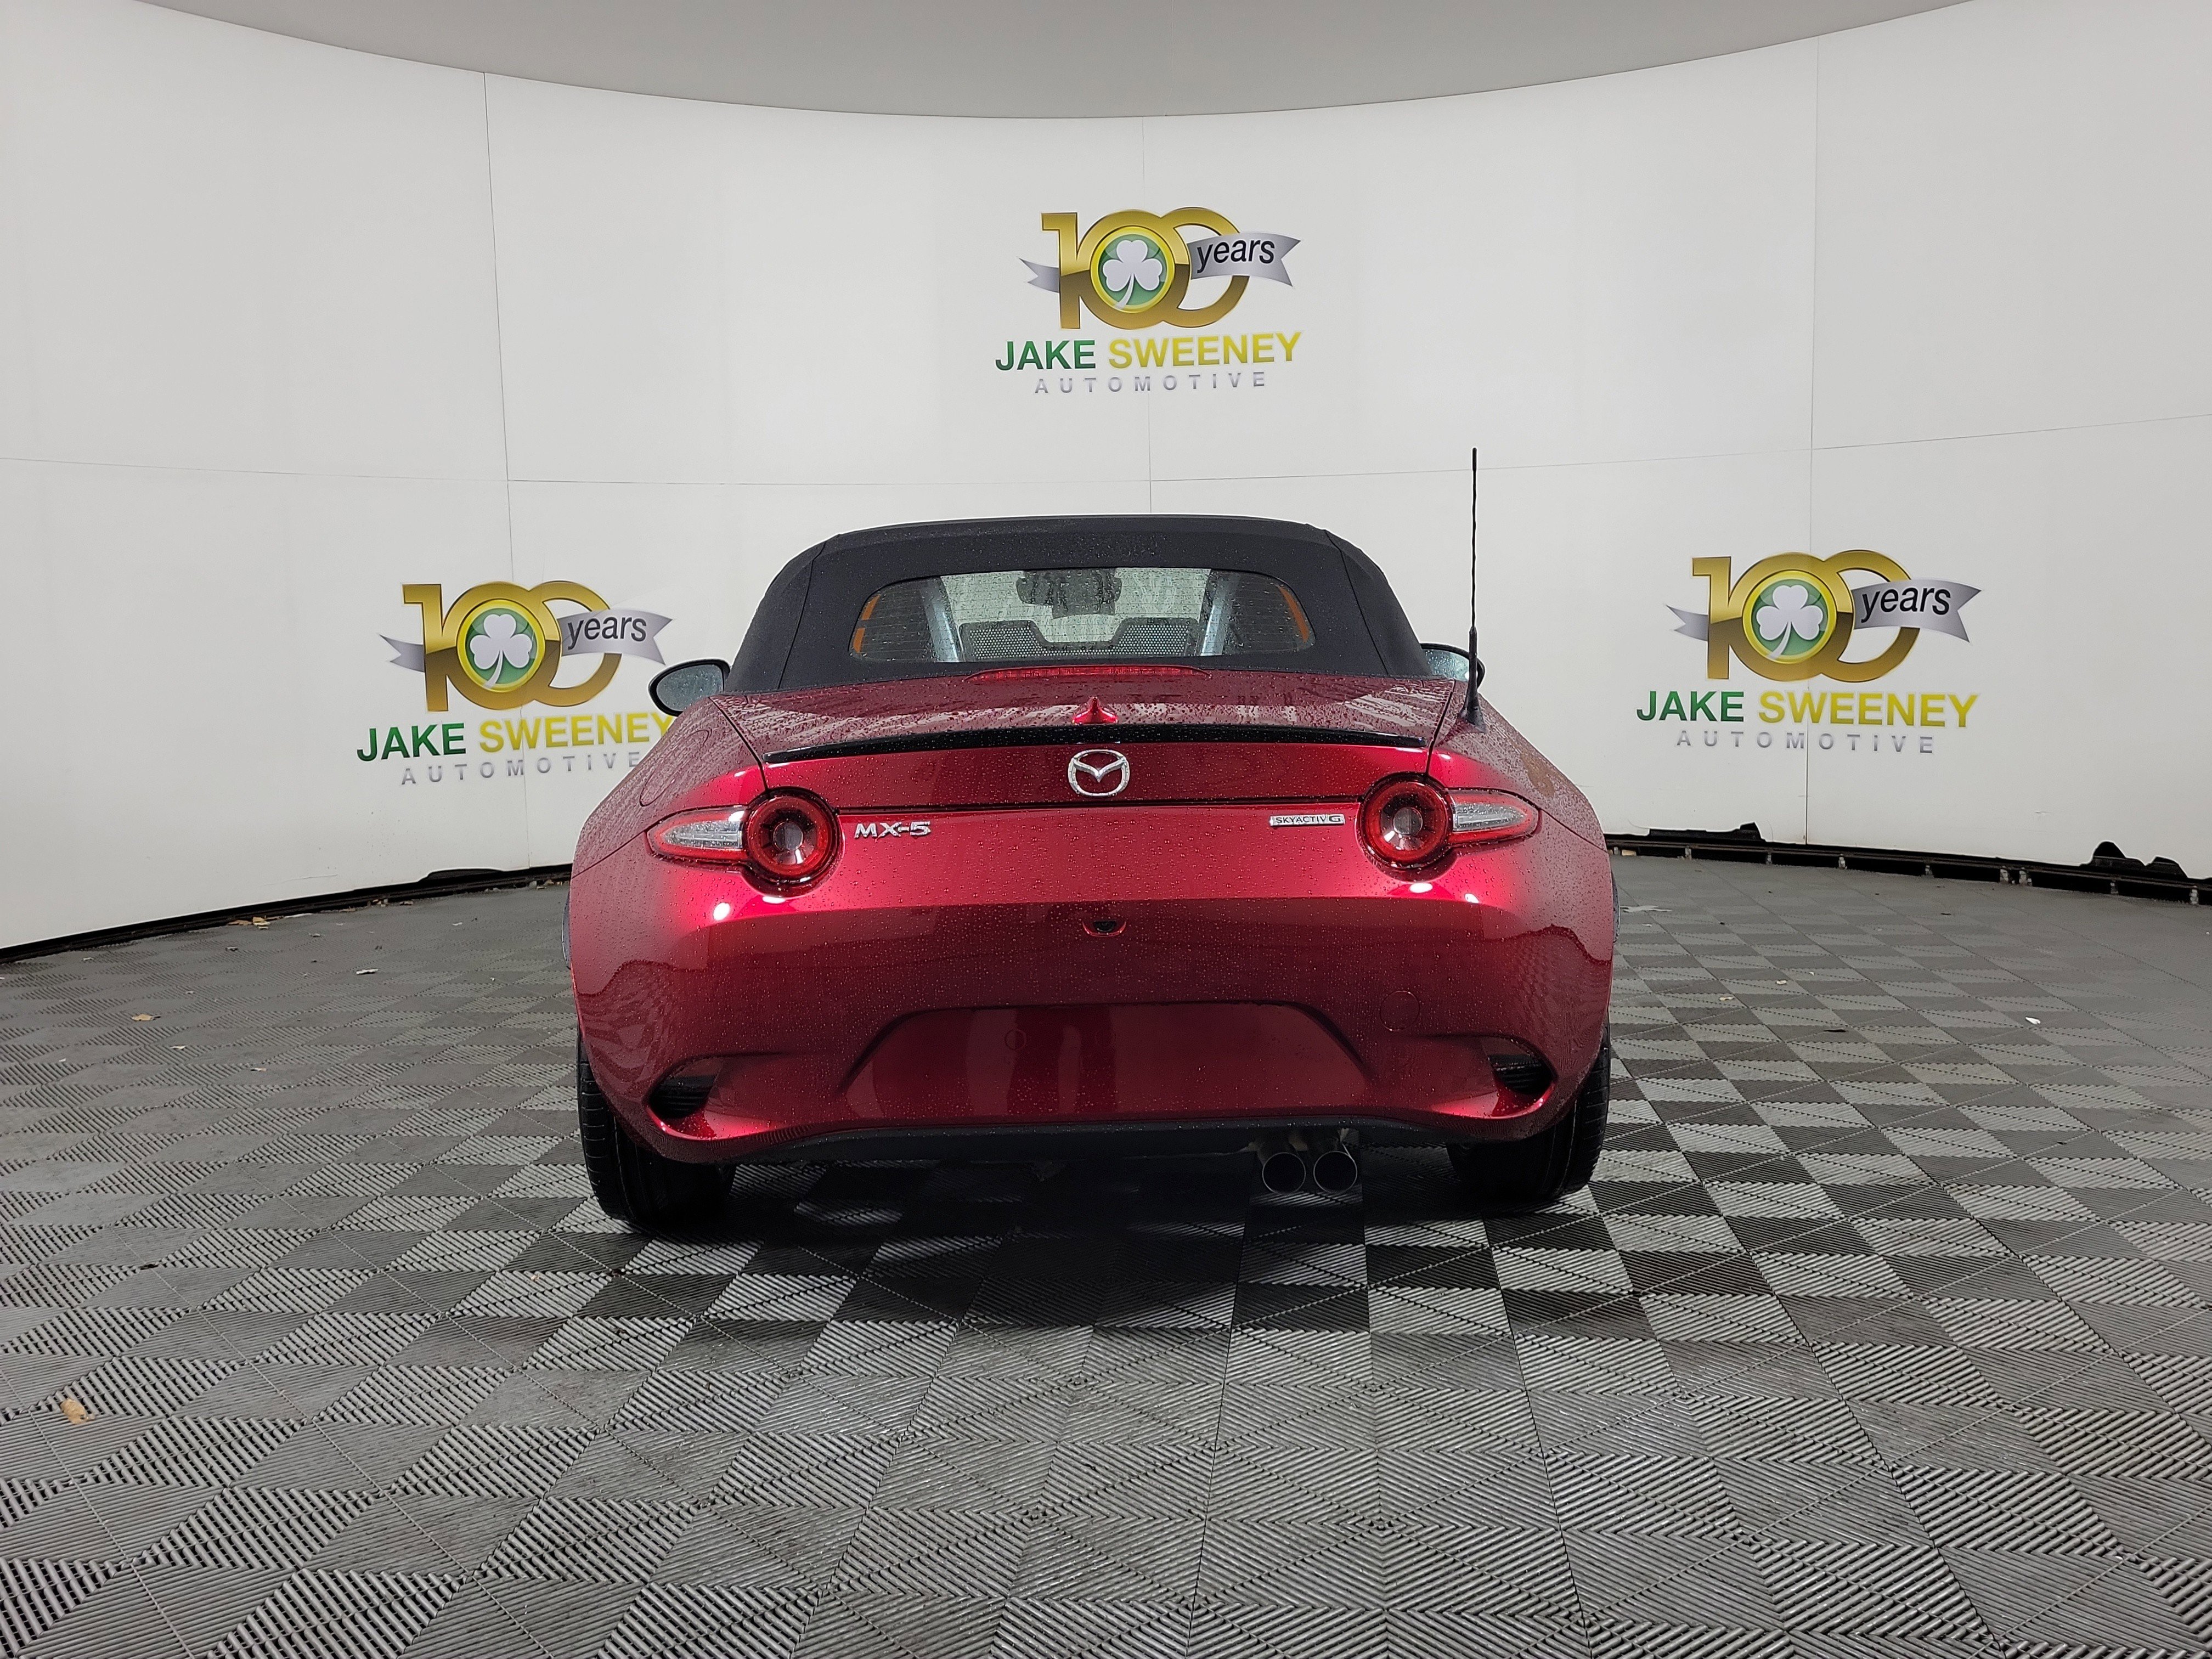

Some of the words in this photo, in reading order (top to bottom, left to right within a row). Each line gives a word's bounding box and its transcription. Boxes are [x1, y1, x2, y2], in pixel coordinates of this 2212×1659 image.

[1041, 207, 1250, 330] 100
[1197, 238, 1276, 274] years
[995, 340, 1096, 371] JAKE
[1109, 332, 1302, 370] SWEENEY
[1035, 371, 1265, 394] AUTOMOTIVE
[1692, 549, 1920, 682] 100
[1861, 586, 1951, 623] years
[402, 580, 622, 712] 100
[567, 617, 647, 650] years
[1636, 690, 1744, 723] JAKE
[1758, 691, 1979, 728] SWEENEY
[357, 723, 466, 762] JAKE
[479, 712, 674, 754] SWEENEY
[1677, 730, 1933, 754] AUTOMOTIVE
[401, 752, 640, 785] AUTOMOTIVE
[854, 821, 932, 839] MX-5
